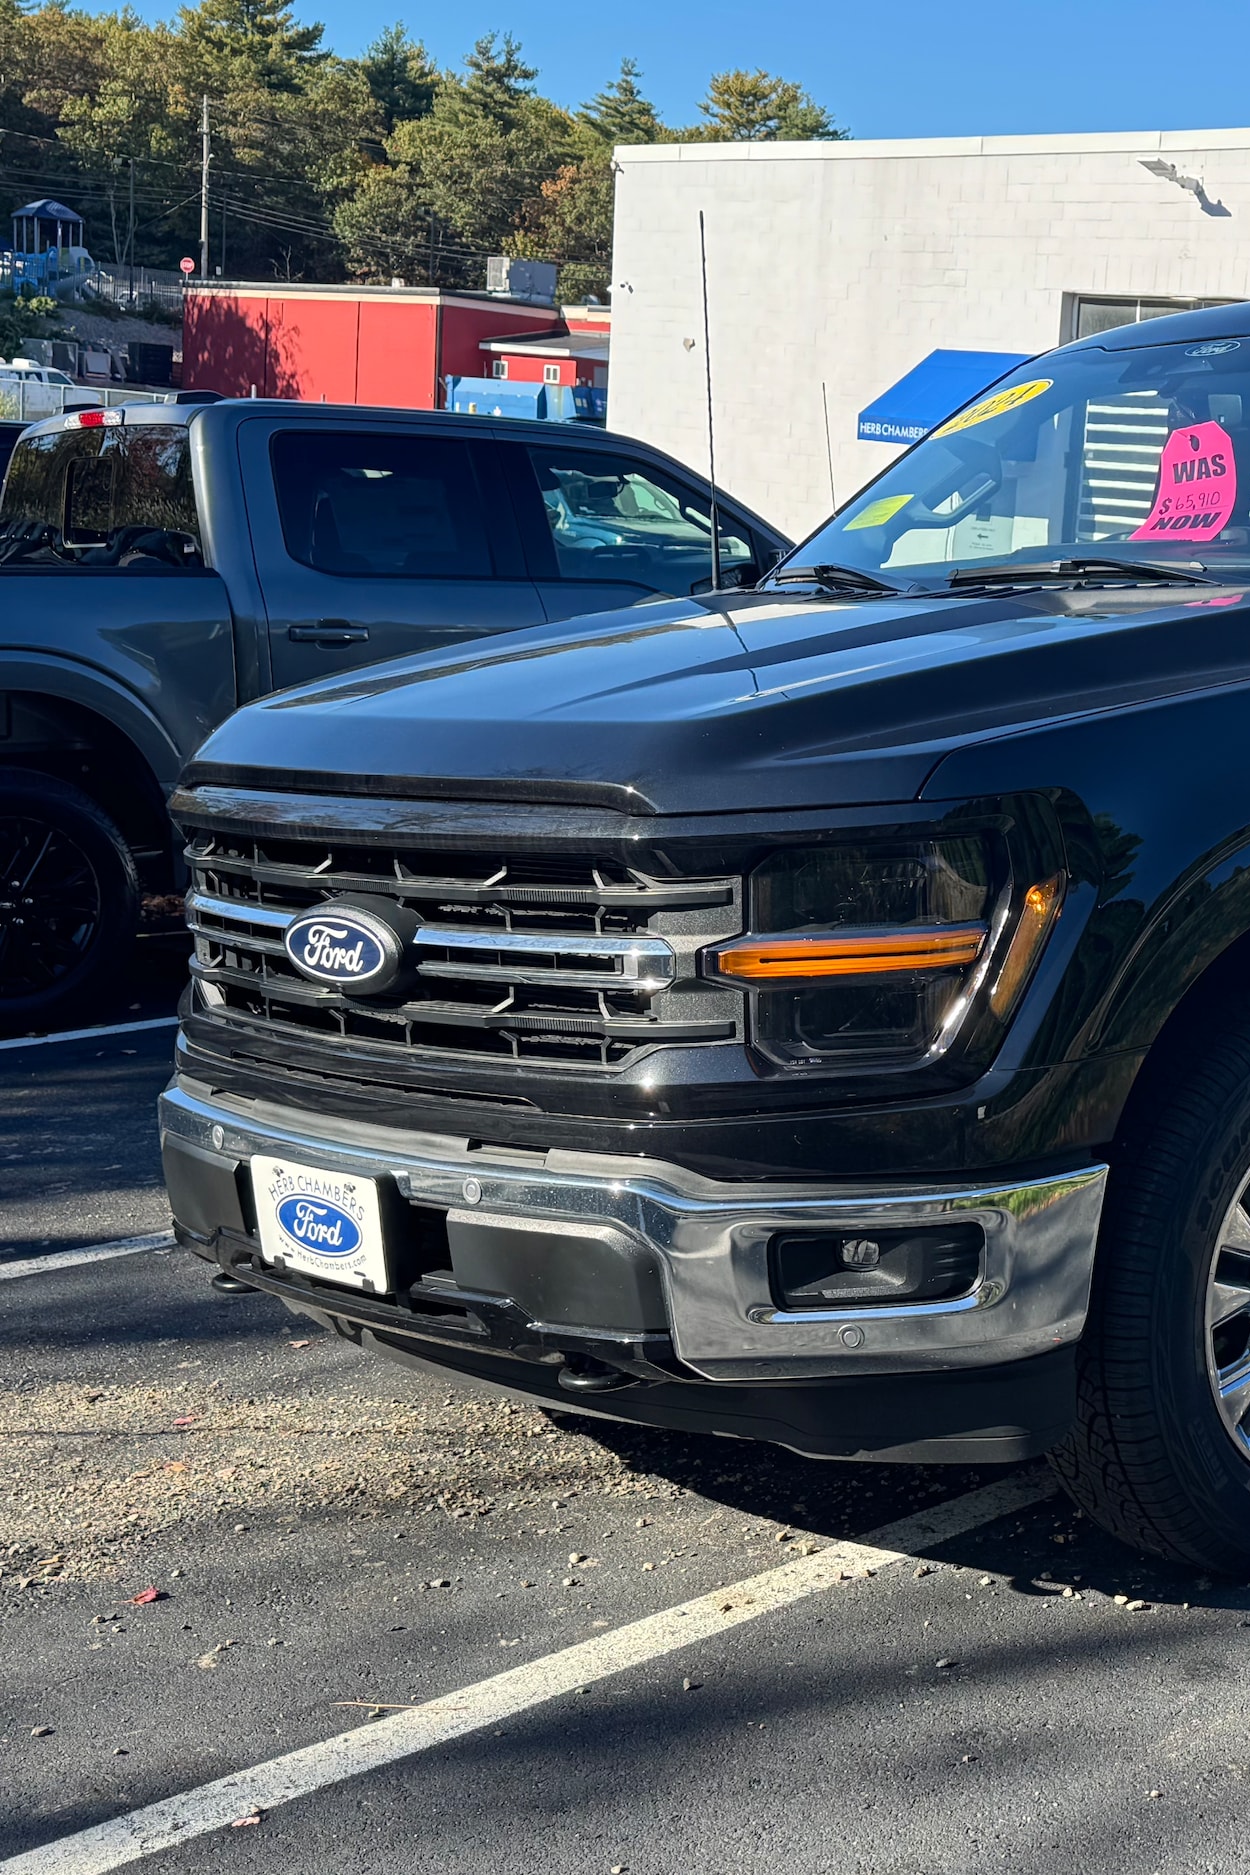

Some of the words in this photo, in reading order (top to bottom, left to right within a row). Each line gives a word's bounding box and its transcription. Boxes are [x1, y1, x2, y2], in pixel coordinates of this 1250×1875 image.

[1191, 342, 1232, 355] Ford
[860, 423, 881, 435] HERB
[1173, 453, 1227, 484] WAS
[1150, 512, 1222, 531] NOW
[303, 924, 364, 973] Ford
[268, 1175, 295, 1201] HERB
[297, 1175, 365, 1221] CHAMBERS
[293, 1201, 344, 1247] Ford
